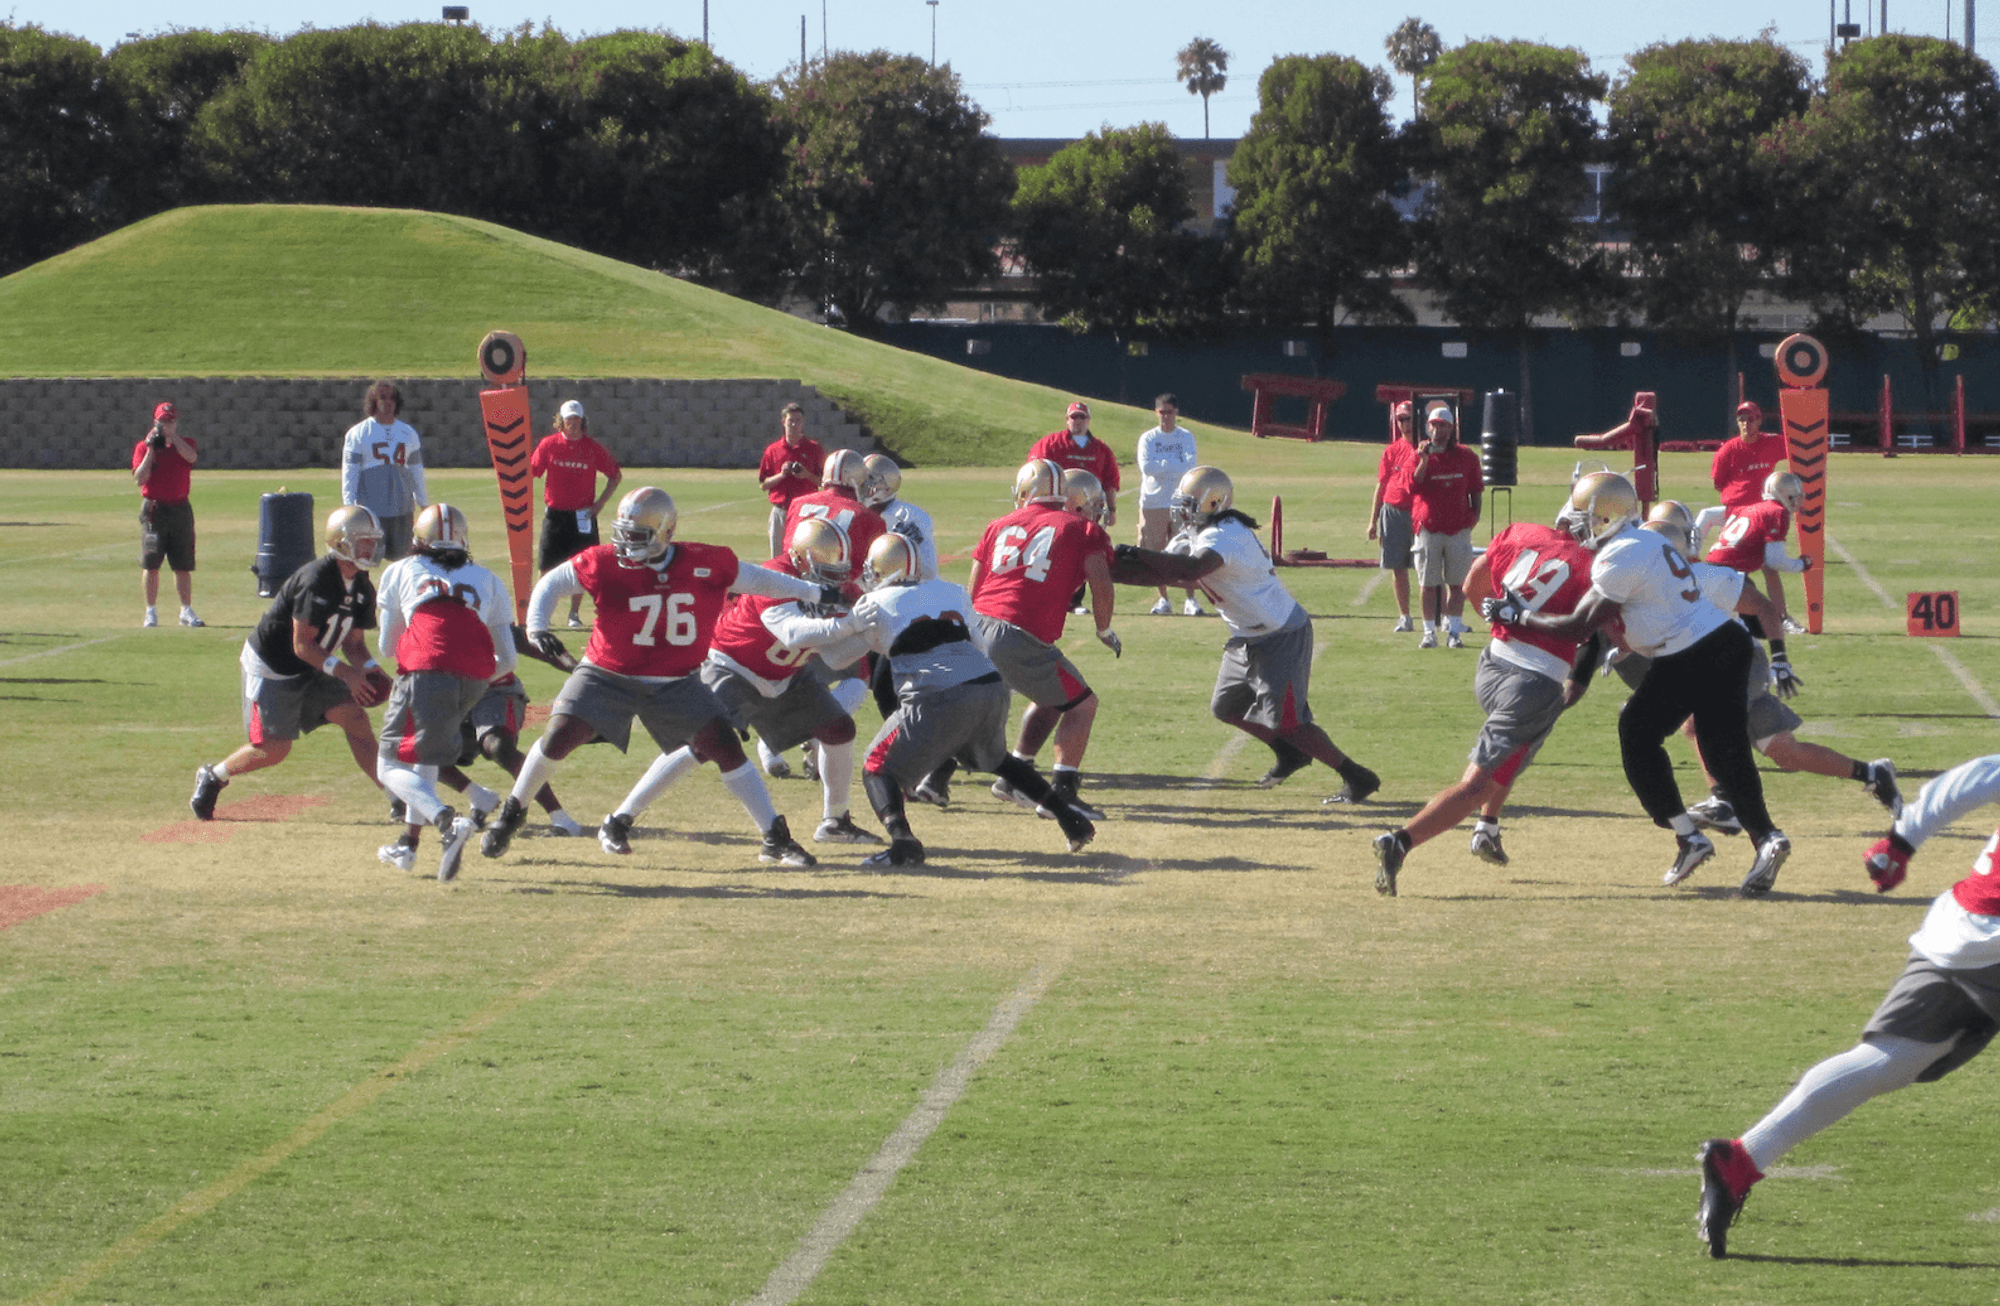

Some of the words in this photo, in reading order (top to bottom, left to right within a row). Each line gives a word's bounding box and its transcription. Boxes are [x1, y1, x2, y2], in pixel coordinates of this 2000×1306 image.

[372, 442, 405, 465] 54
[991, 525, 1056, 583] 64
[320, 612, 354, 653] 11
[629, 592, 697, 647] 76
[1911, 594, 1955, 630] 40
